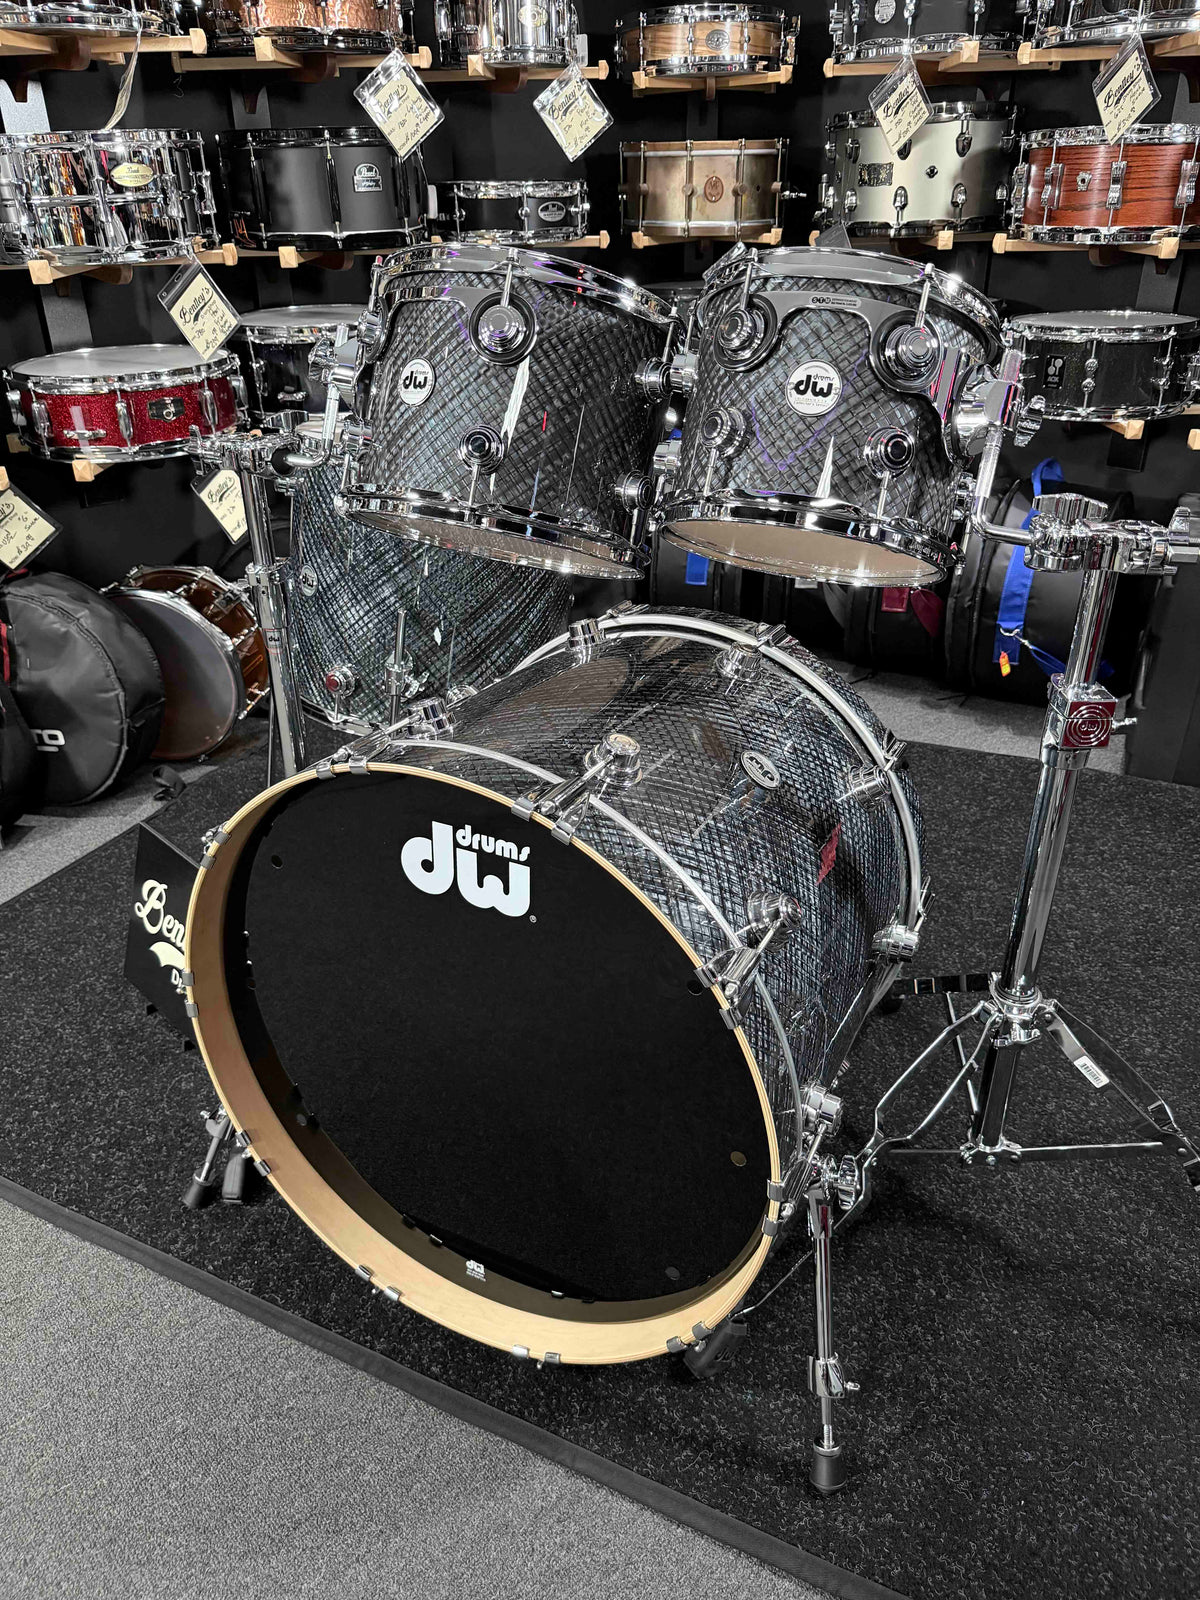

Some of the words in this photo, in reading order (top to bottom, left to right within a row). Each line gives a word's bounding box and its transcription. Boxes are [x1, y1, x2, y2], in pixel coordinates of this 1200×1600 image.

[548, 84, 582, 120] Bentley's
[179, 287, 210, 326] Bentley's
[402, 371, 428, 390] dw
[793, 374, 833, 398] dw
[1080, 721, 1098, 731] dw
[749, 756, 775, 782] dw
[456, 824, 530, 862] drums
[401, 821, 530, 917] dw
